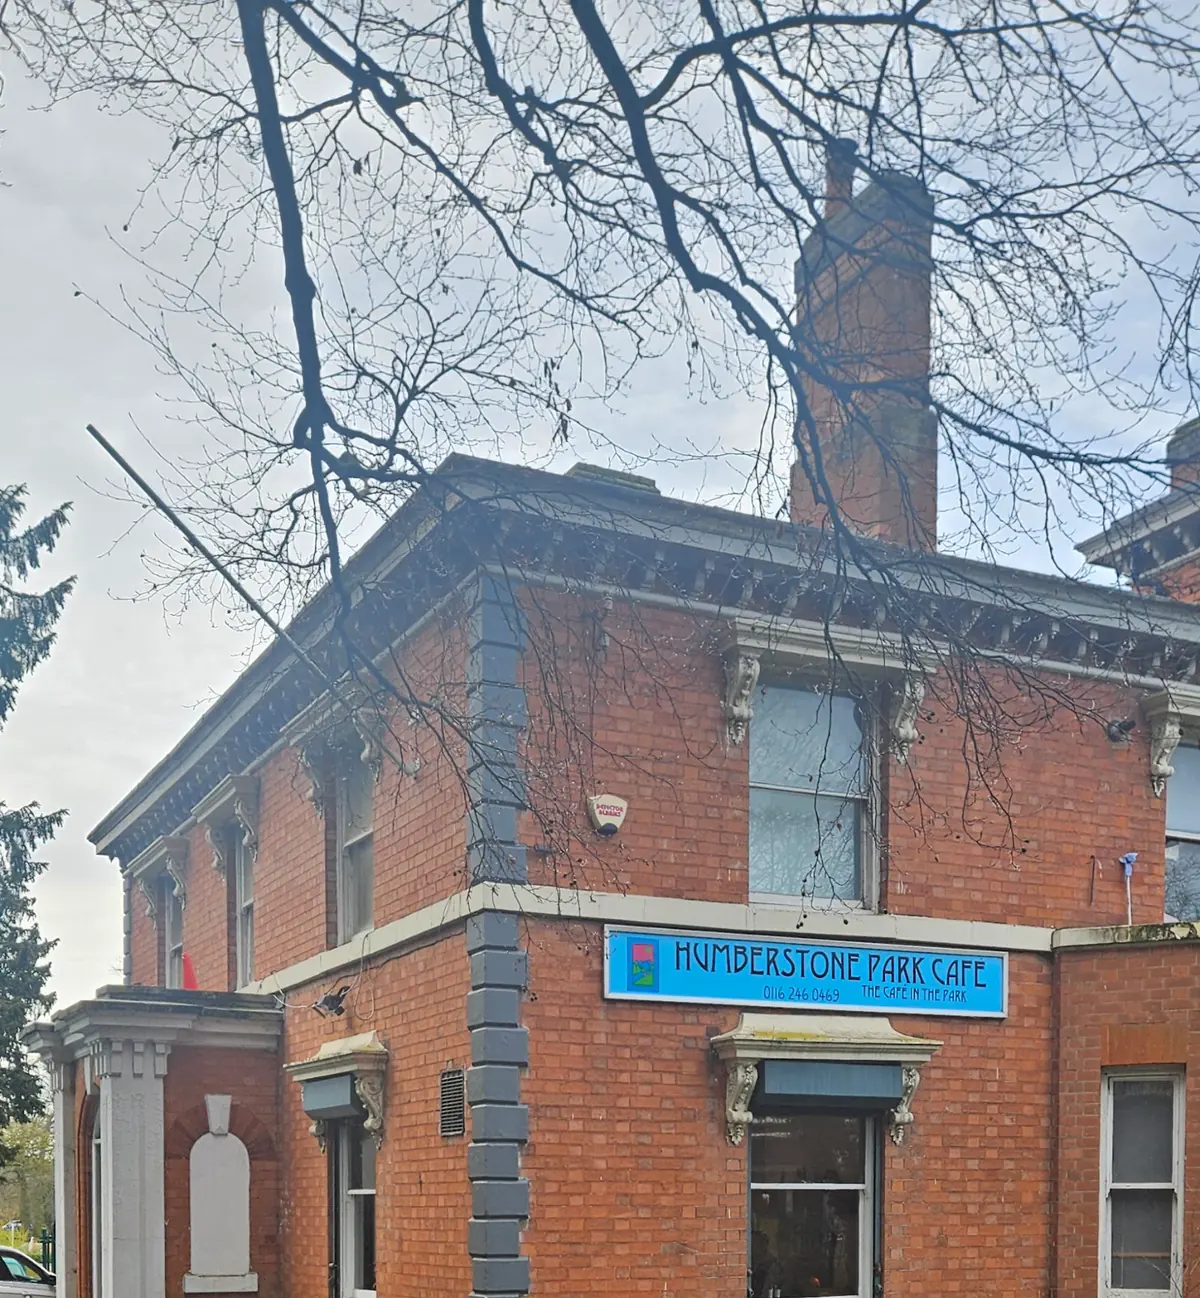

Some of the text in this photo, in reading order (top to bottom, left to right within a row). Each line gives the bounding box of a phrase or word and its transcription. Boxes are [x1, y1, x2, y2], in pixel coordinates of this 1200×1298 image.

[676, 941, 987, 988] HUMBERSTONE PARK CAFÉ
[763, 985, 840, 1002] 0116 246 0469
[862, 983, 967, 1003] THE CAFÉ IN THE PARK
